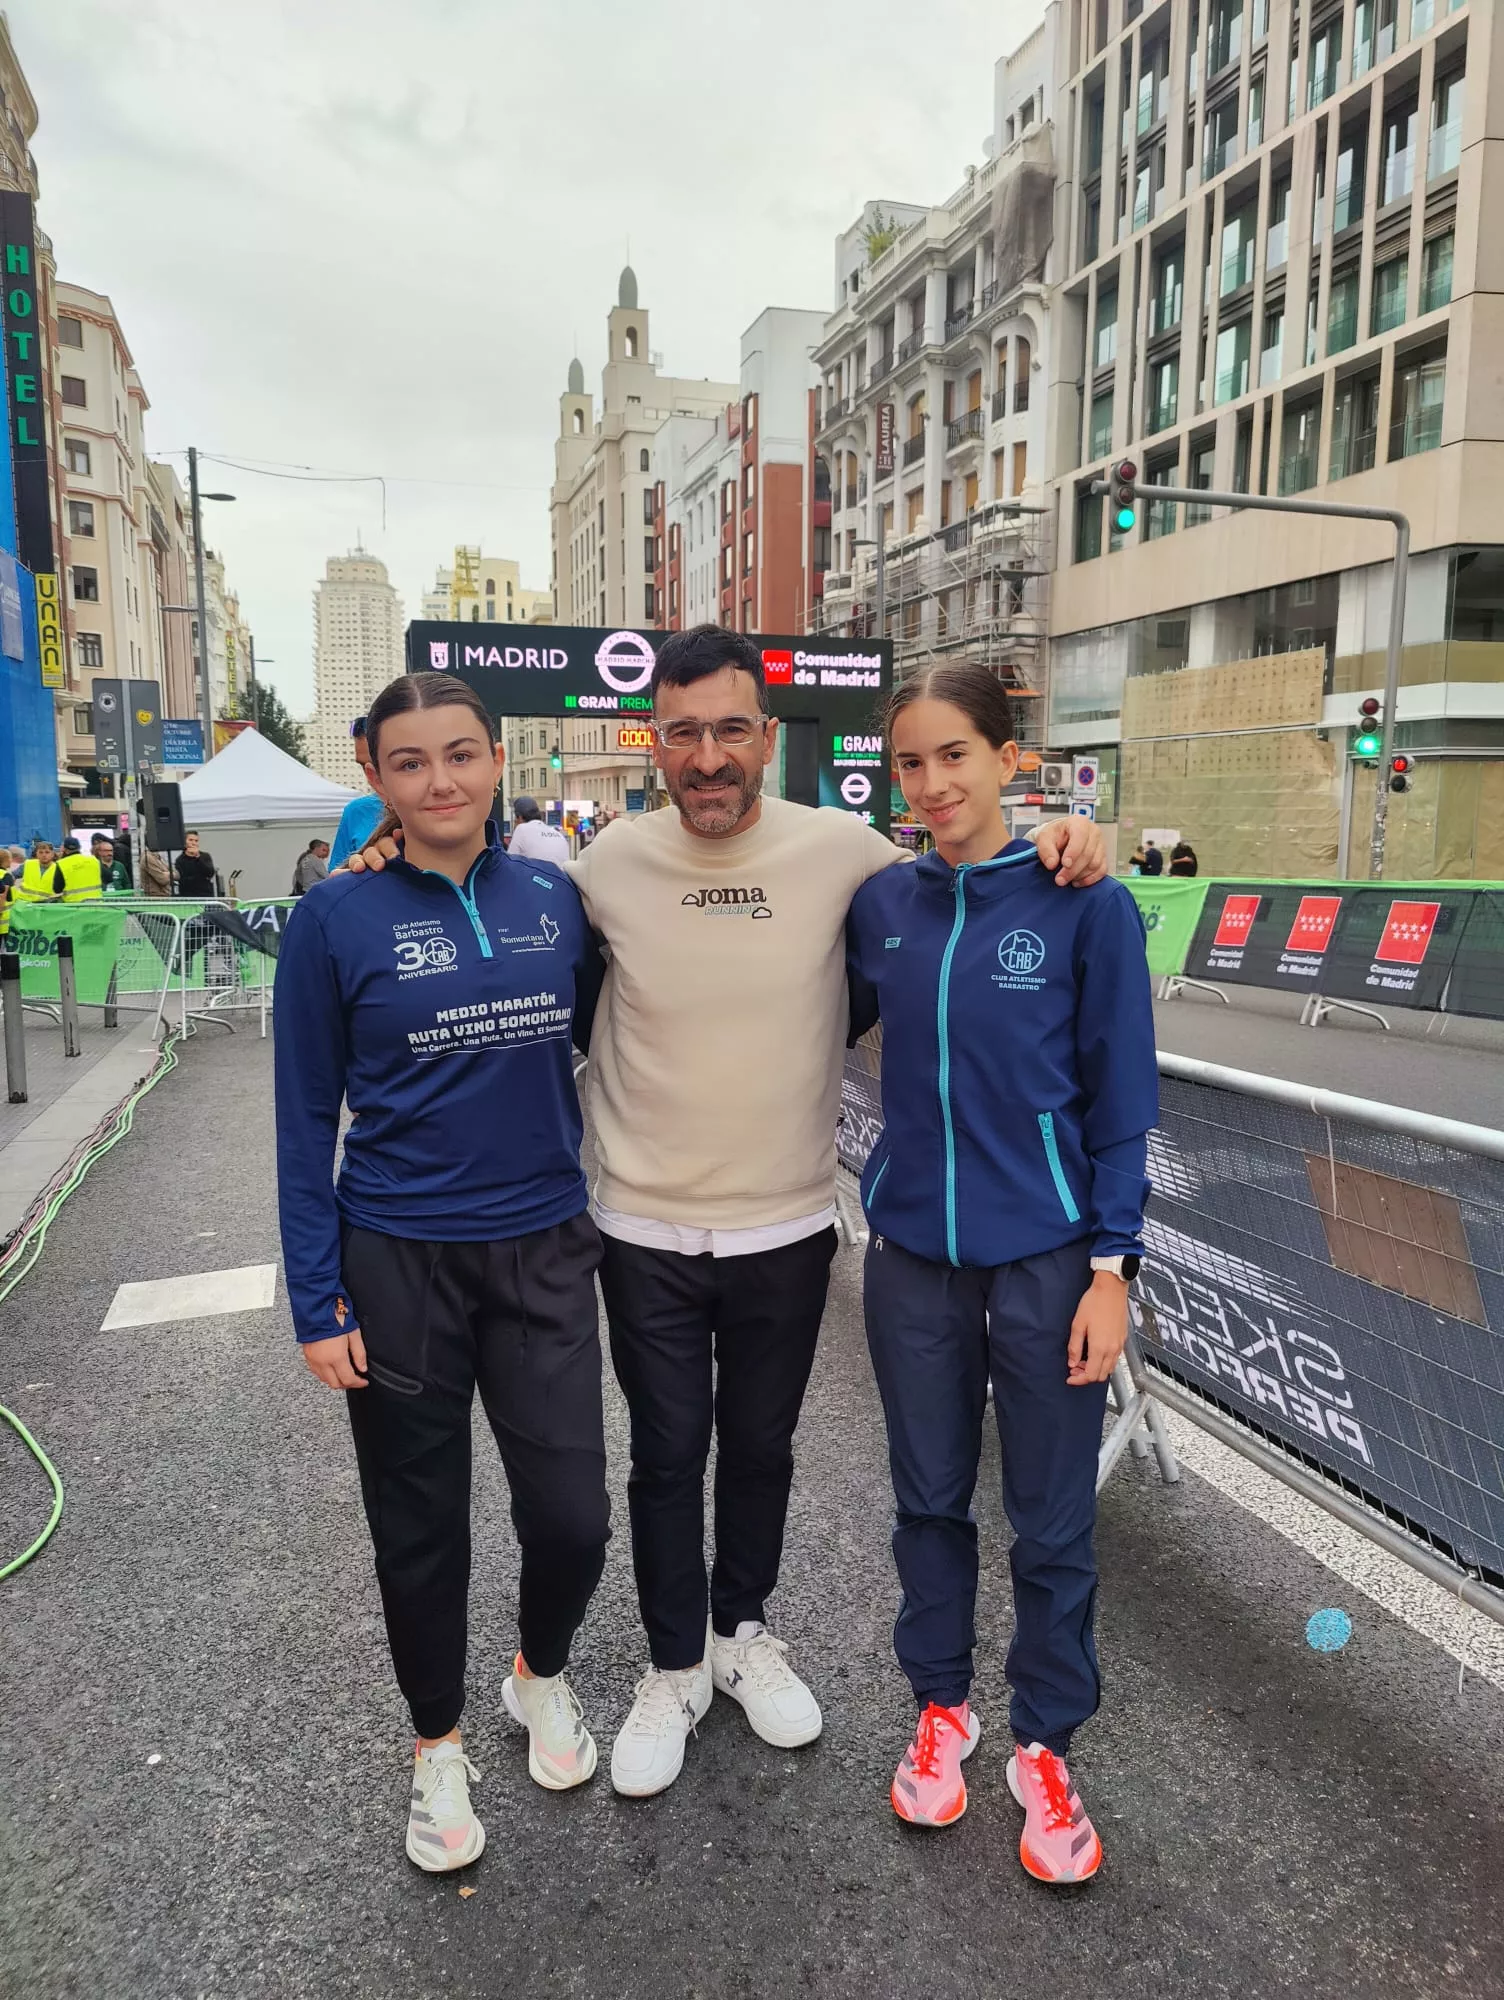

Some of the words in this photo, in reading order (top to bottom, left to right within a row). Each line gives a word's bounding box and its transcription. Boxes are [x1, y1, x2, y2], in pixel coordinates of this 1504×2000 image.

[6, 243, 39, 446] HOTEL
[881, 406, 890, 454] LAURIA
[226, 636, 236, 694] HOTEL
[464, 645, 569, 669] MADRID
[794, 650, 881, 668] Comunidad
[794, 669, 816, 685] de
[820, 670, 880, 687] Madrid
[578, 695, 618, 709] GRAN
[620, 697, 653, 709] PREM
[843, 735, 882, 752] GRAN
[392, 923, 409, 931] Club
[410, 919, 441, 928] Atletismo
[395, 926, 444, 940] Barbastro
[500, 934, 545, 944] Somontano
[1008, 950, 1033, 970] CAB
[1217, 958, 1241, 969] Madrid
[1280, 953, 1323, 966] Comunidad
[398, 964, 459, 981] ANIVERSARIO
[1288, 964, 1319, 977] Madrid
[1370, 963, 1419, 978] Comunidad
[998, 982, 1040, 991] BARBASTRO
[1008, 975, 1047, 984] ATLETISMO
[1365, 975, 1380, 985] de
[1380, 976, 1415, 991] Madrid
[436, 1003, 488, 1023] MEDIO
[491, 991, 556, 1013] MARATÓN
[407, 1027, 451, 1044] RUTA
[453, 1019, 495, 1036] VINO
[499, 1008, 572, 1030] SOMONTANO
[411, 1046, 428, 1054] Una
[428, 1042, 462, 1053] Carrera.
[463, 1038, 480, 1047] Una
[481, 1034, 503, 1044] Ruta.
[504, 1030, 516, 1040] Un
[517, 1028, 537, 1039] Vino.
[537, 1026, 546, 1035] El
